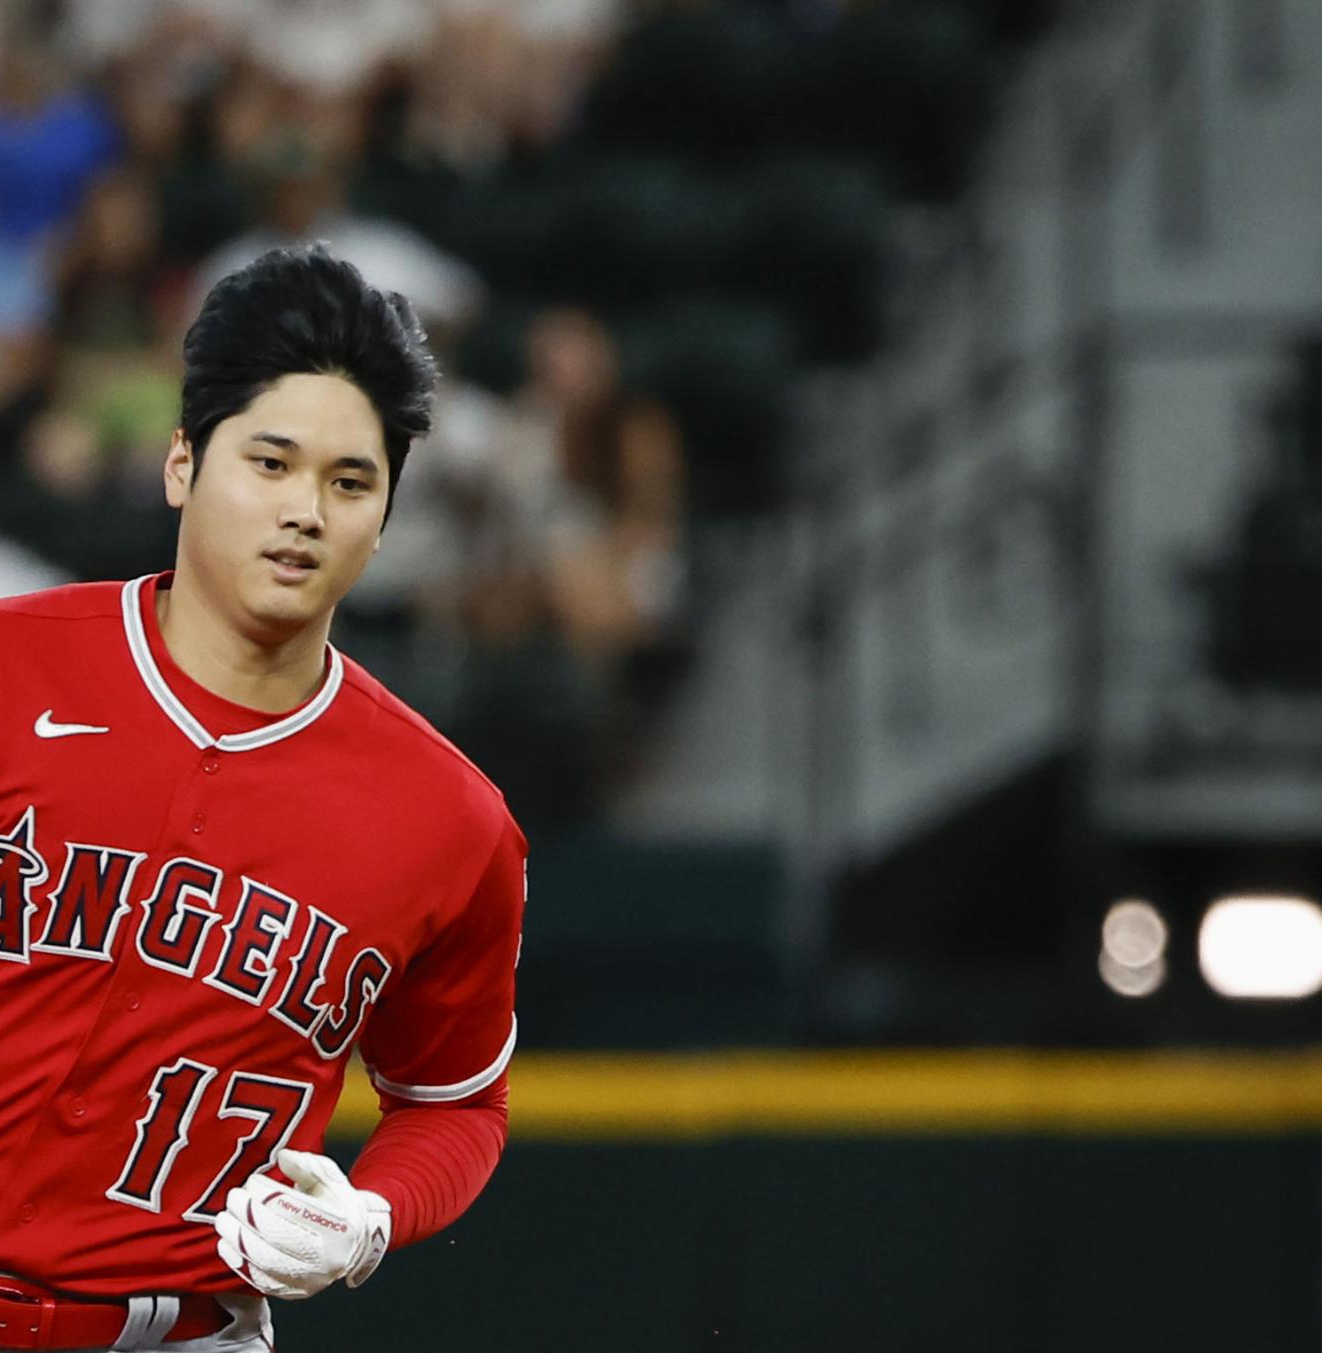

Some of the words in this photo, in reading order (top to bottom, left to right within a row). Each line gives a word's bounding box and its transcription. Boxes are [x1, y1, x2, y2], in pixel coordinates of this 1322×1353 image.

[105, 1056, 315, 1225] 17
[278, 1198, 300, 1215] new
[302, 1208, 348, 1233] balance
